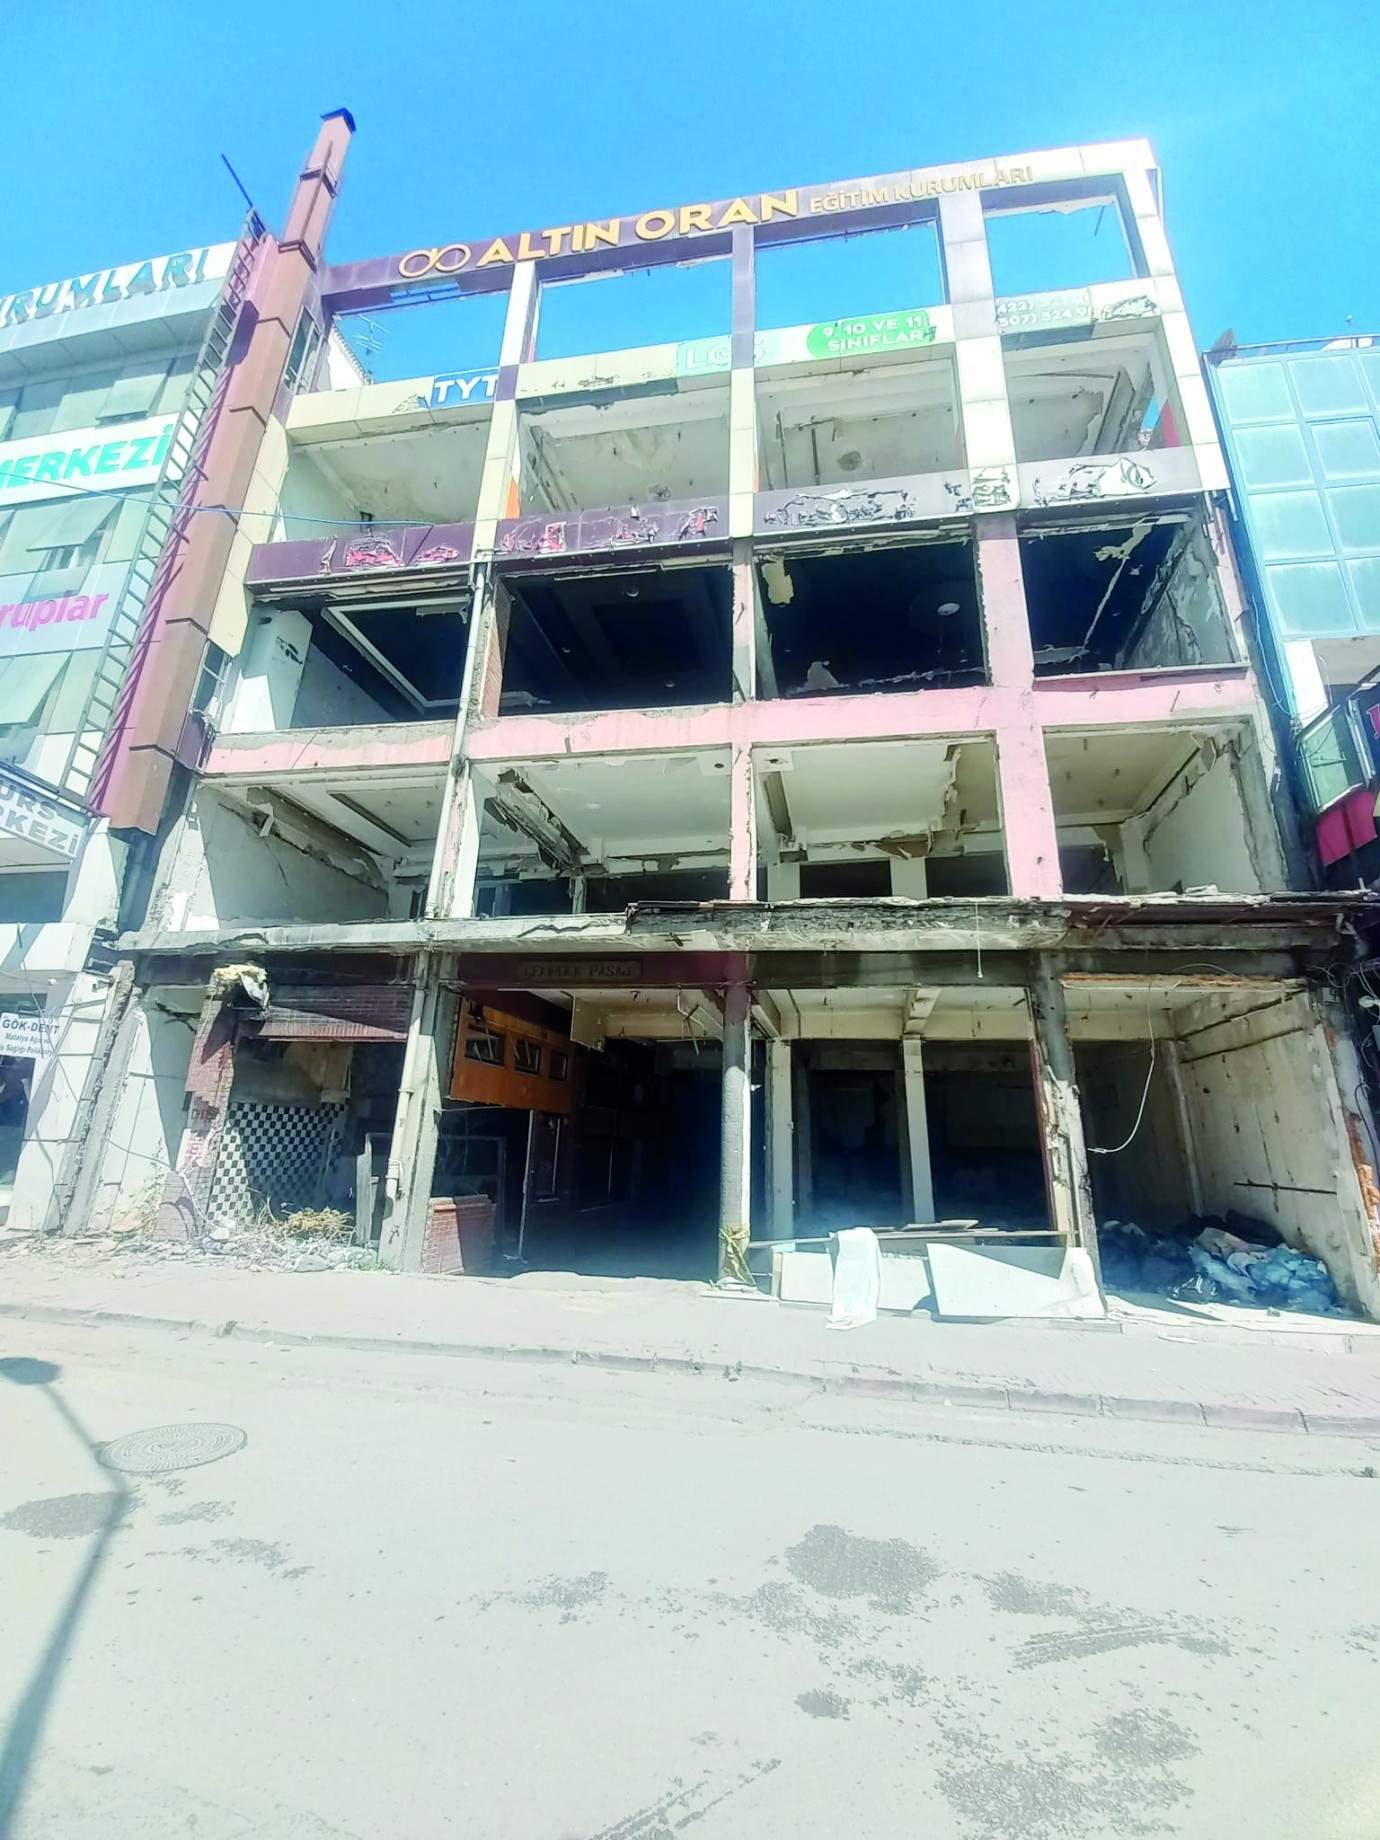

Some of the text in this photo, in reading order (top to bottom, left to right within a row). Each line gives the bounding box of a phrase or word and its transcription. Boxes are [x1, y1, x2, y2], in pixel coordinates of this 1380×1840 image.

[476, 166, 1034, 268] ALTIN ORAN EĞİTİM KURUMLARI
[843, 323, 866, 336] 10
[871, 318, 898, 332] VE
[828, 330, 923, 352] SINIFLAR
[434, 373, 500, 403] TYT
